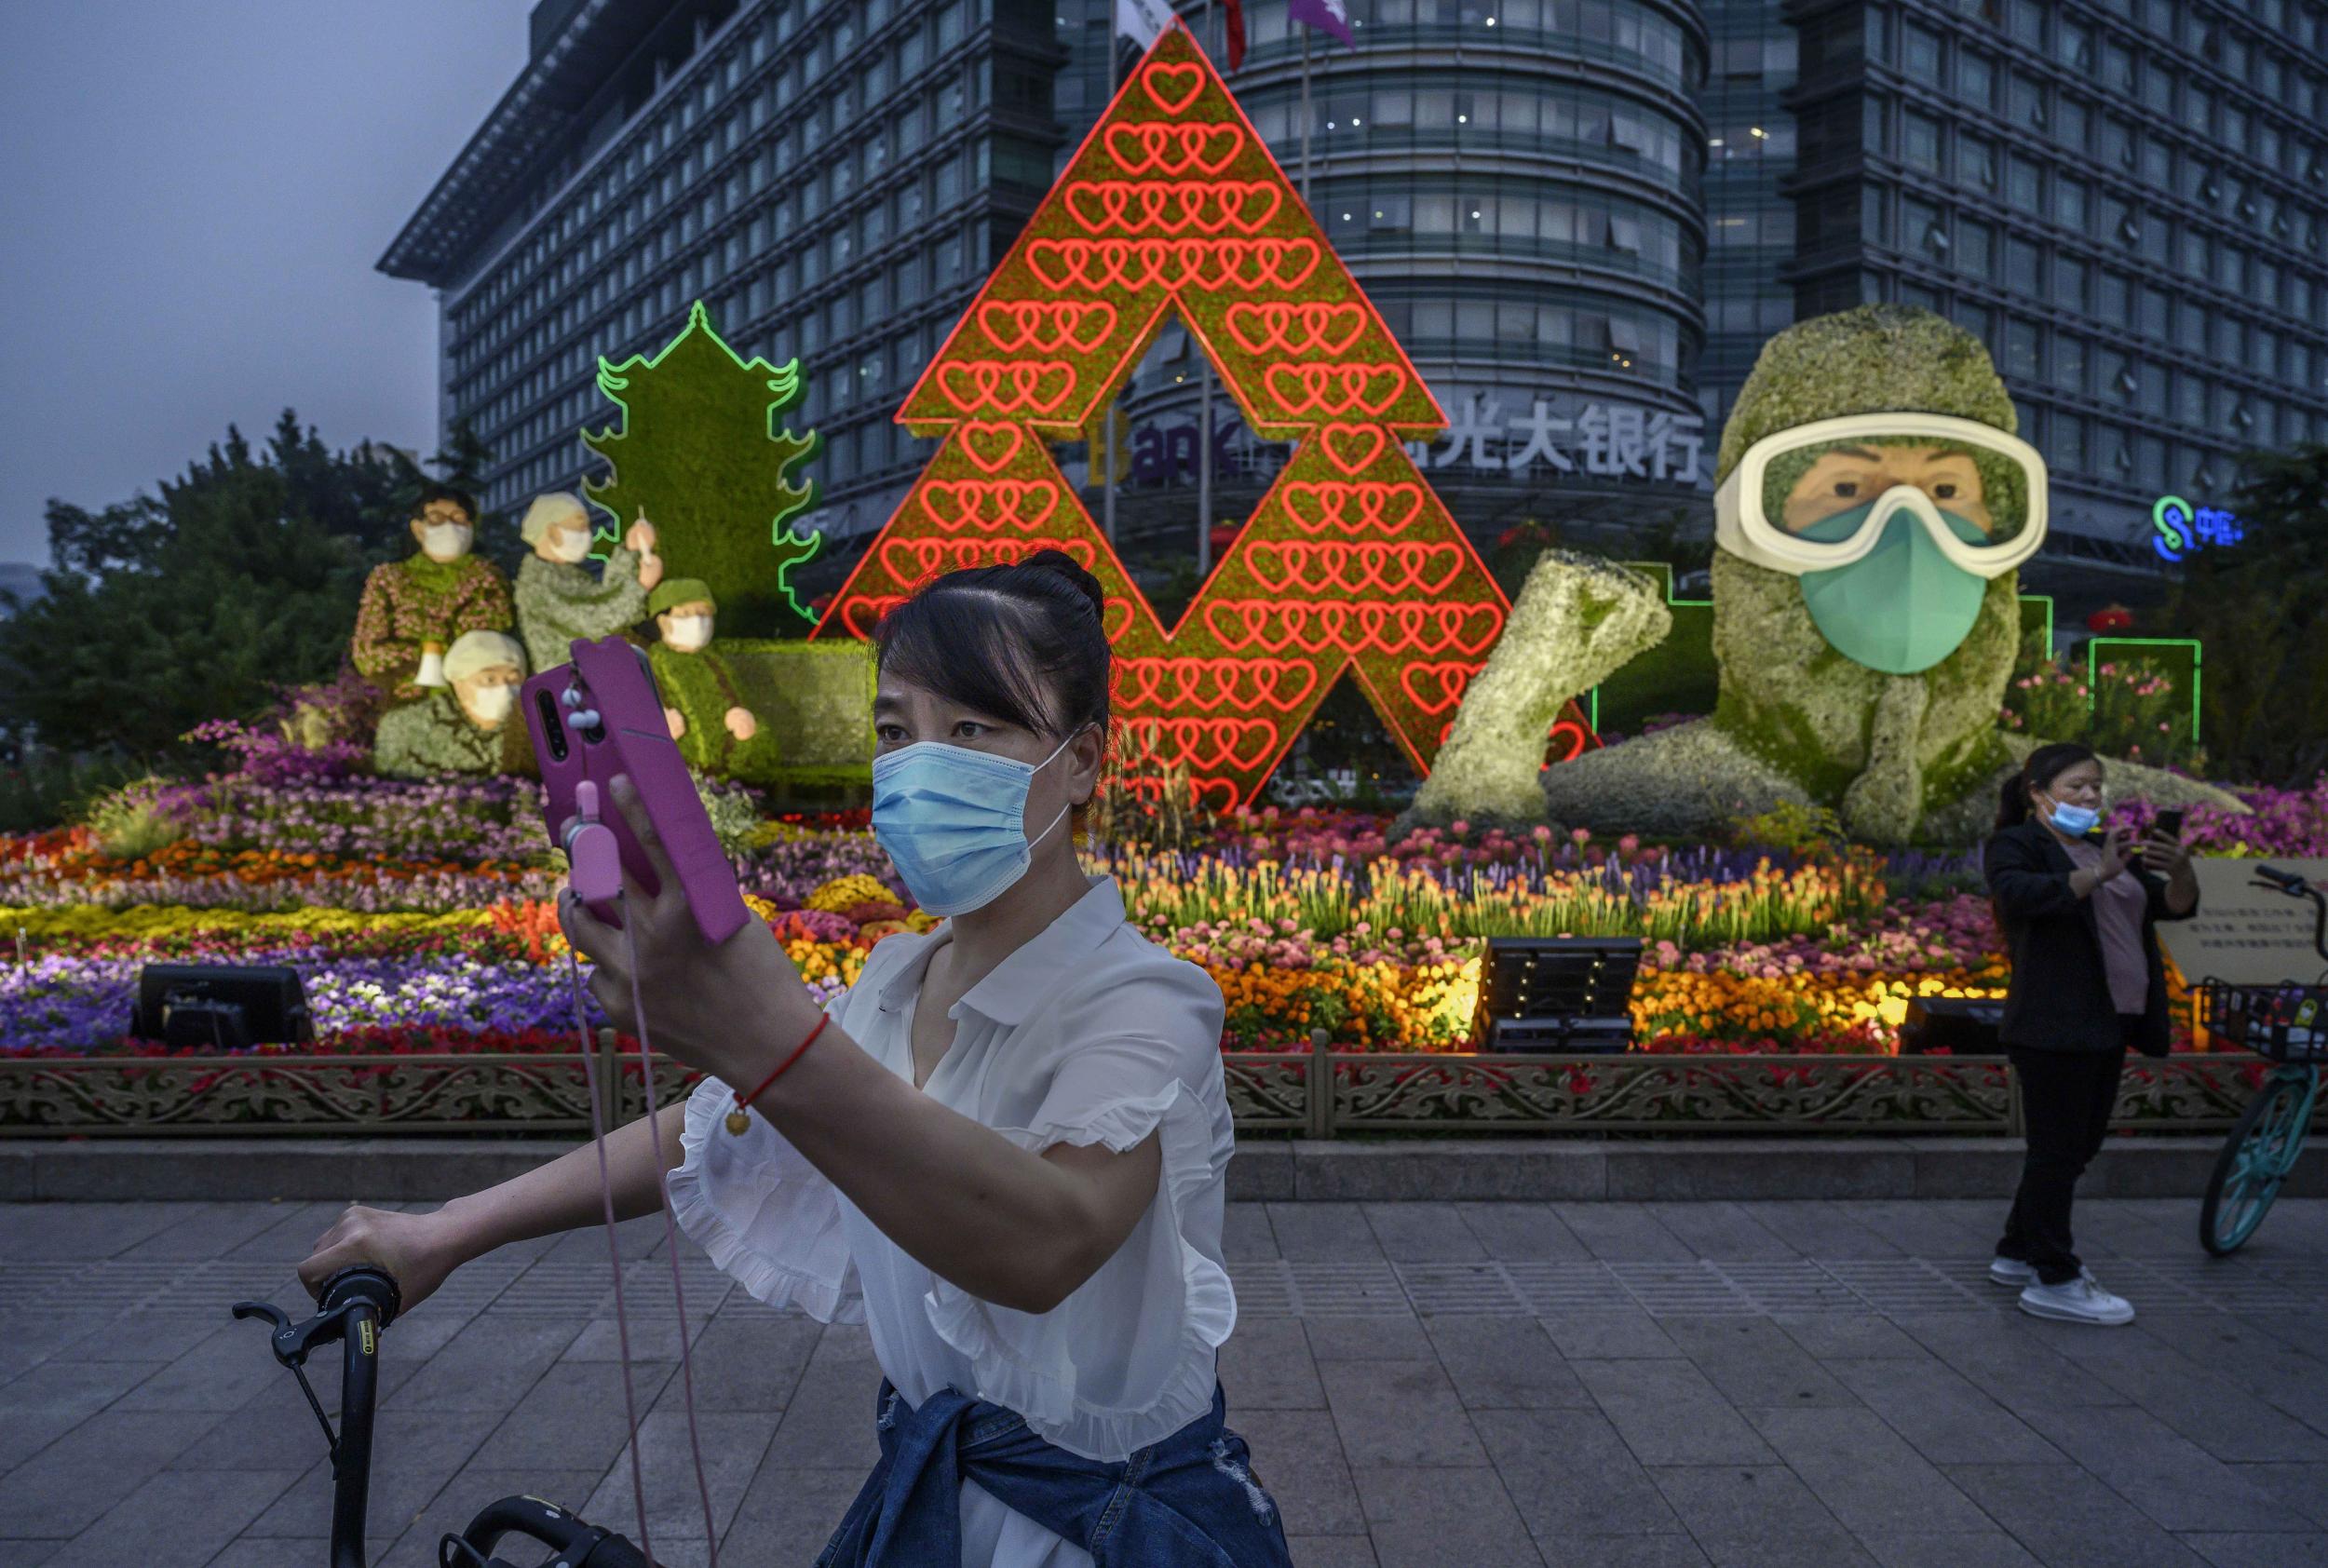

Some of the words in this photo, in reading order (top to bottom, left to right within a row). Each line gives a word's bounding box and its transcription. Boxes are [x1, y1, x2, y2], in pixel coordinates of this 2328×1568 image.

[1088, 408, 1241, 487] Bank
[1405, 400, 1704, 483] 光大银行
